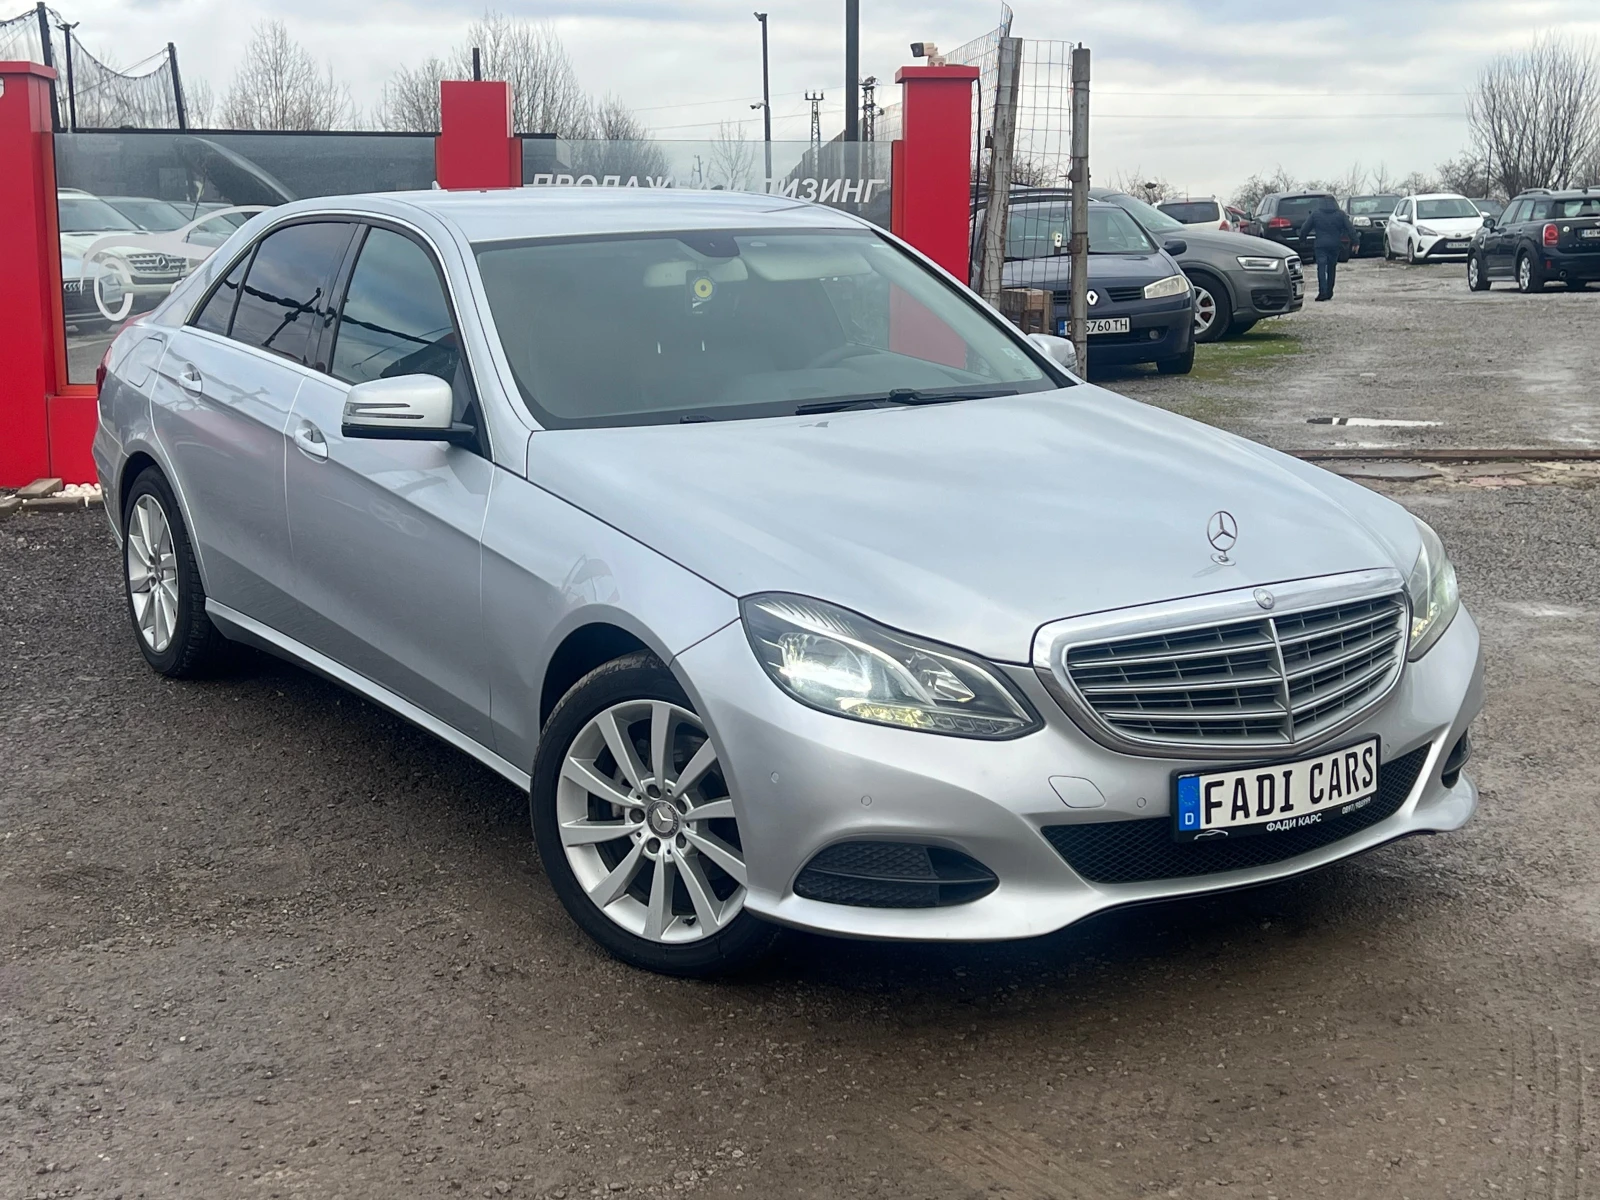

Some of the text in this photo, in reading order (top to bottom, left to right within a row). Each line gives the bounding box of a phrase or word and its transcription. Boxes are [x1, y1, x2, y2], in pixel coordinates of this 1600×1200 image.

[1113, 319, 1128, 331] TH
[1204, 746, 1374, 825] FADI CARS
[1184, 812, 1194, 825] D
[1266, 813, 1322, 832] ФАДИ КАРС
